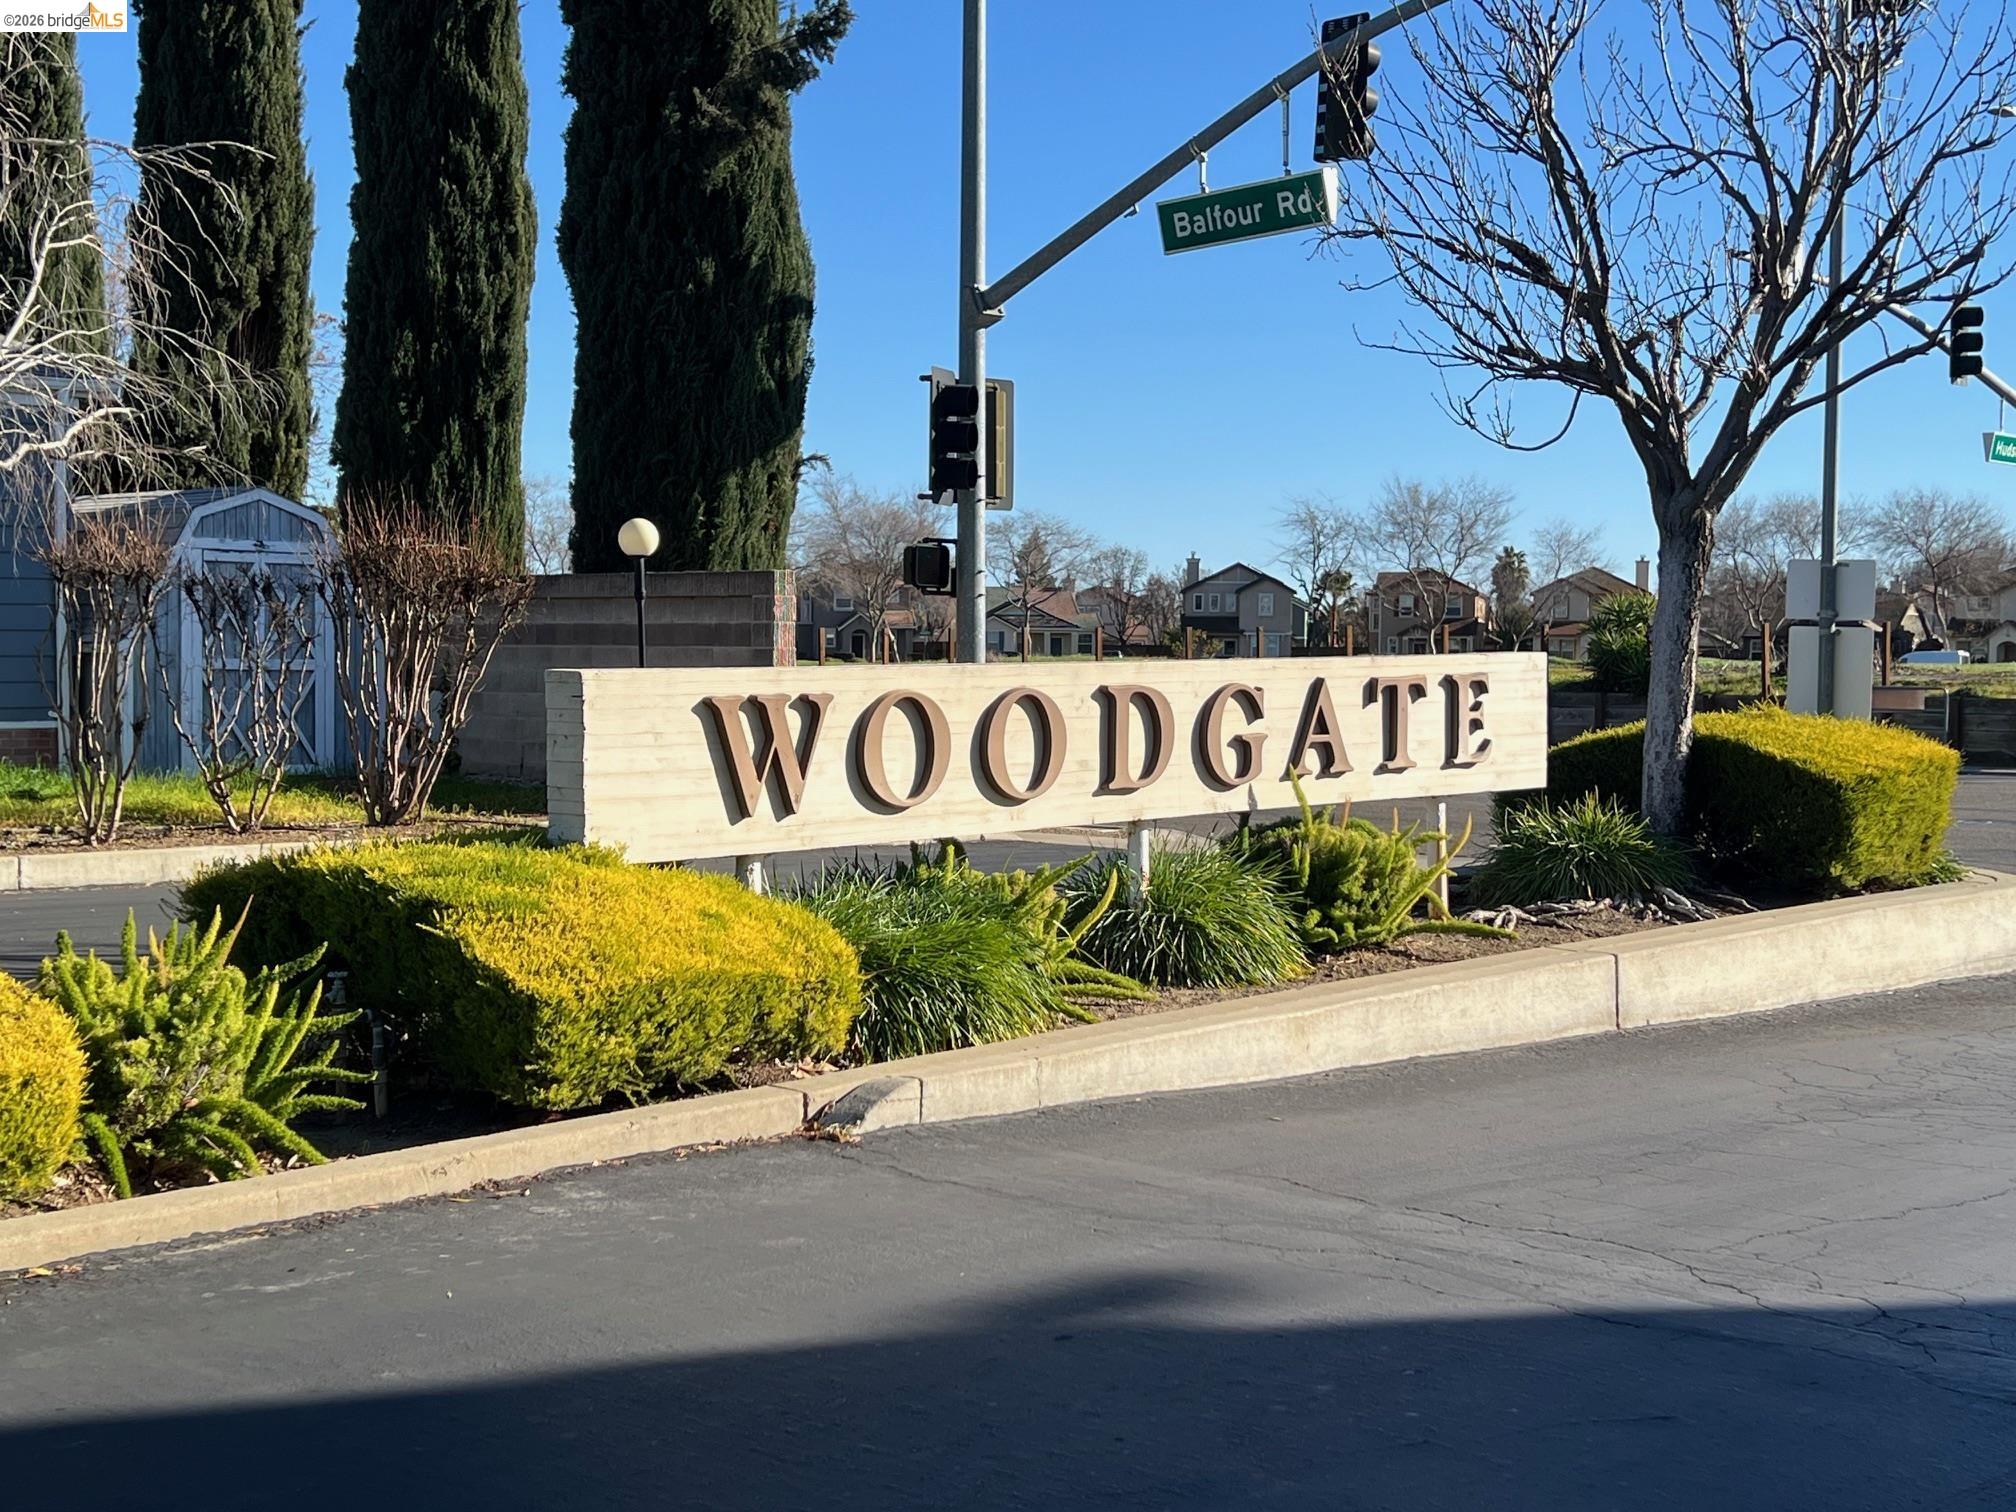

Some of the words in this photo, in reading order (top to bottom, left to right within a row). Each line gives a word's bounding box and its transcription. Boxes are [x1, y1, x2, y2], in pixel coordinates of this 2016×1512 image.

[1173, 202, 1263, 238] Balfour
[1277, 188, 1313, 218] Rd
[698, 672, 1492, 820] WOODGATE
